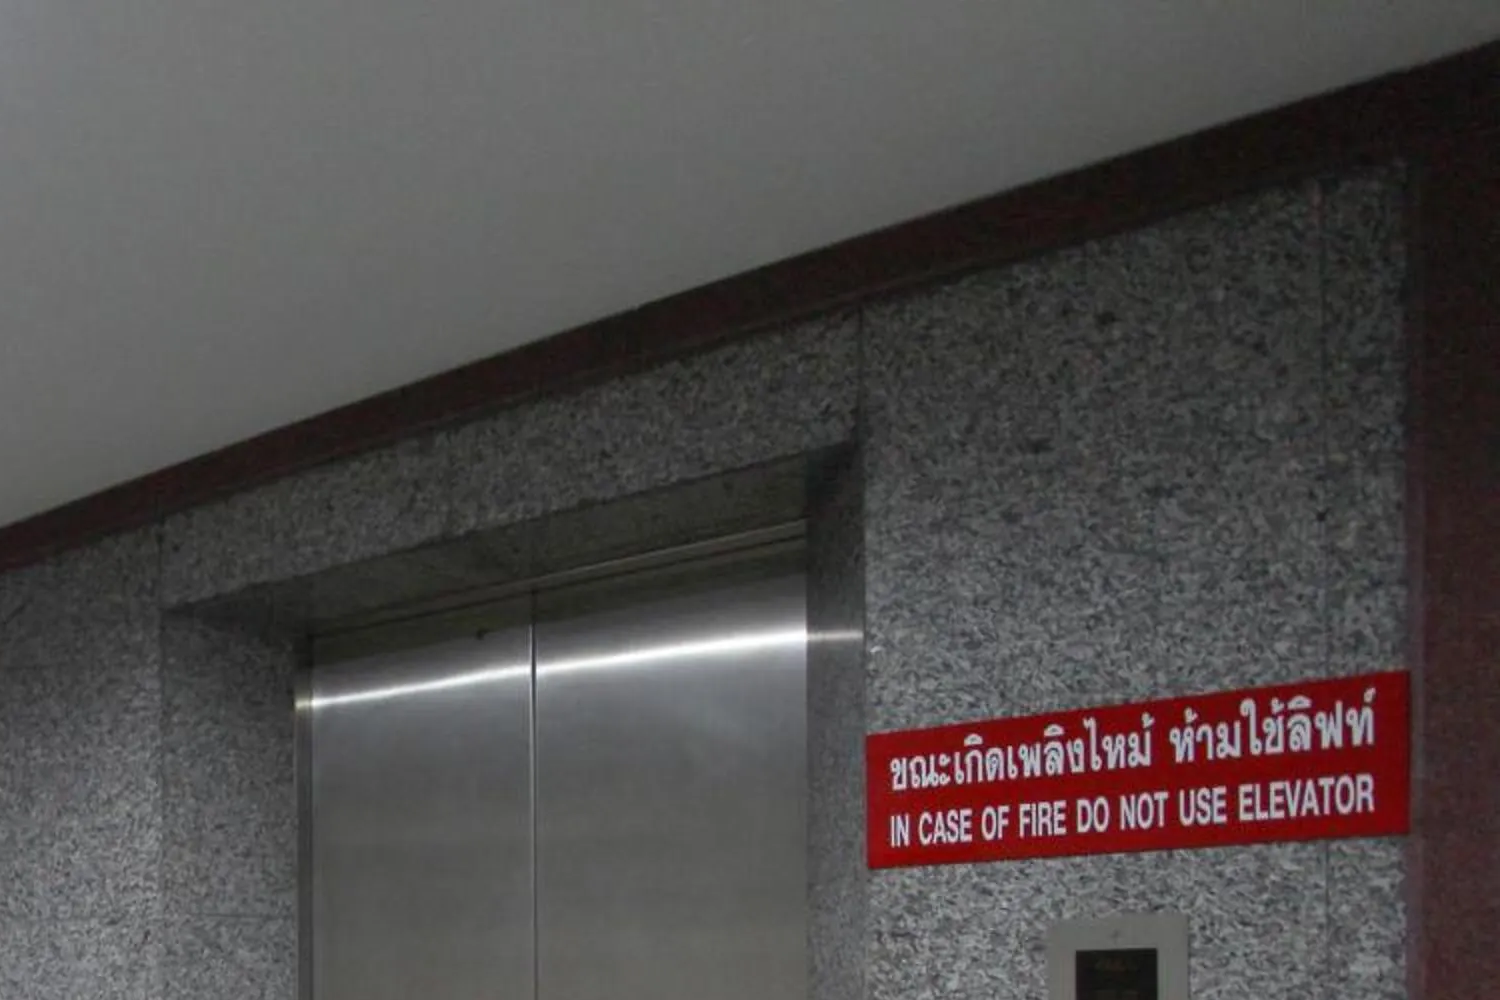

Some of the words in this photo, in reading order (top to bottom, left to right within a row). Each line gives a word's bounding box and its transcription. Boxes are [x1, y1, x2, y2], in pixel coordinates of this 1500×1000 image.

[890, 713, 1155, 792] ขณะเกิดเพลิงไหม้
[1169, 687, 1376, 763] ห้ามใช้ลิฟท์
[890, 813, 911, 848] IN
[918, 808, 973, 845] CASE
[982, 805, 1011, 841] OF
[1019, 800, 1067, 838] FIRE
[1077, 796, 1110, 834] DO
[1120, 792, 1169, 831] NOT
[1179, 786, 1228, 827] USE
[1239, 774, 1375, 822] ELEVATOR
